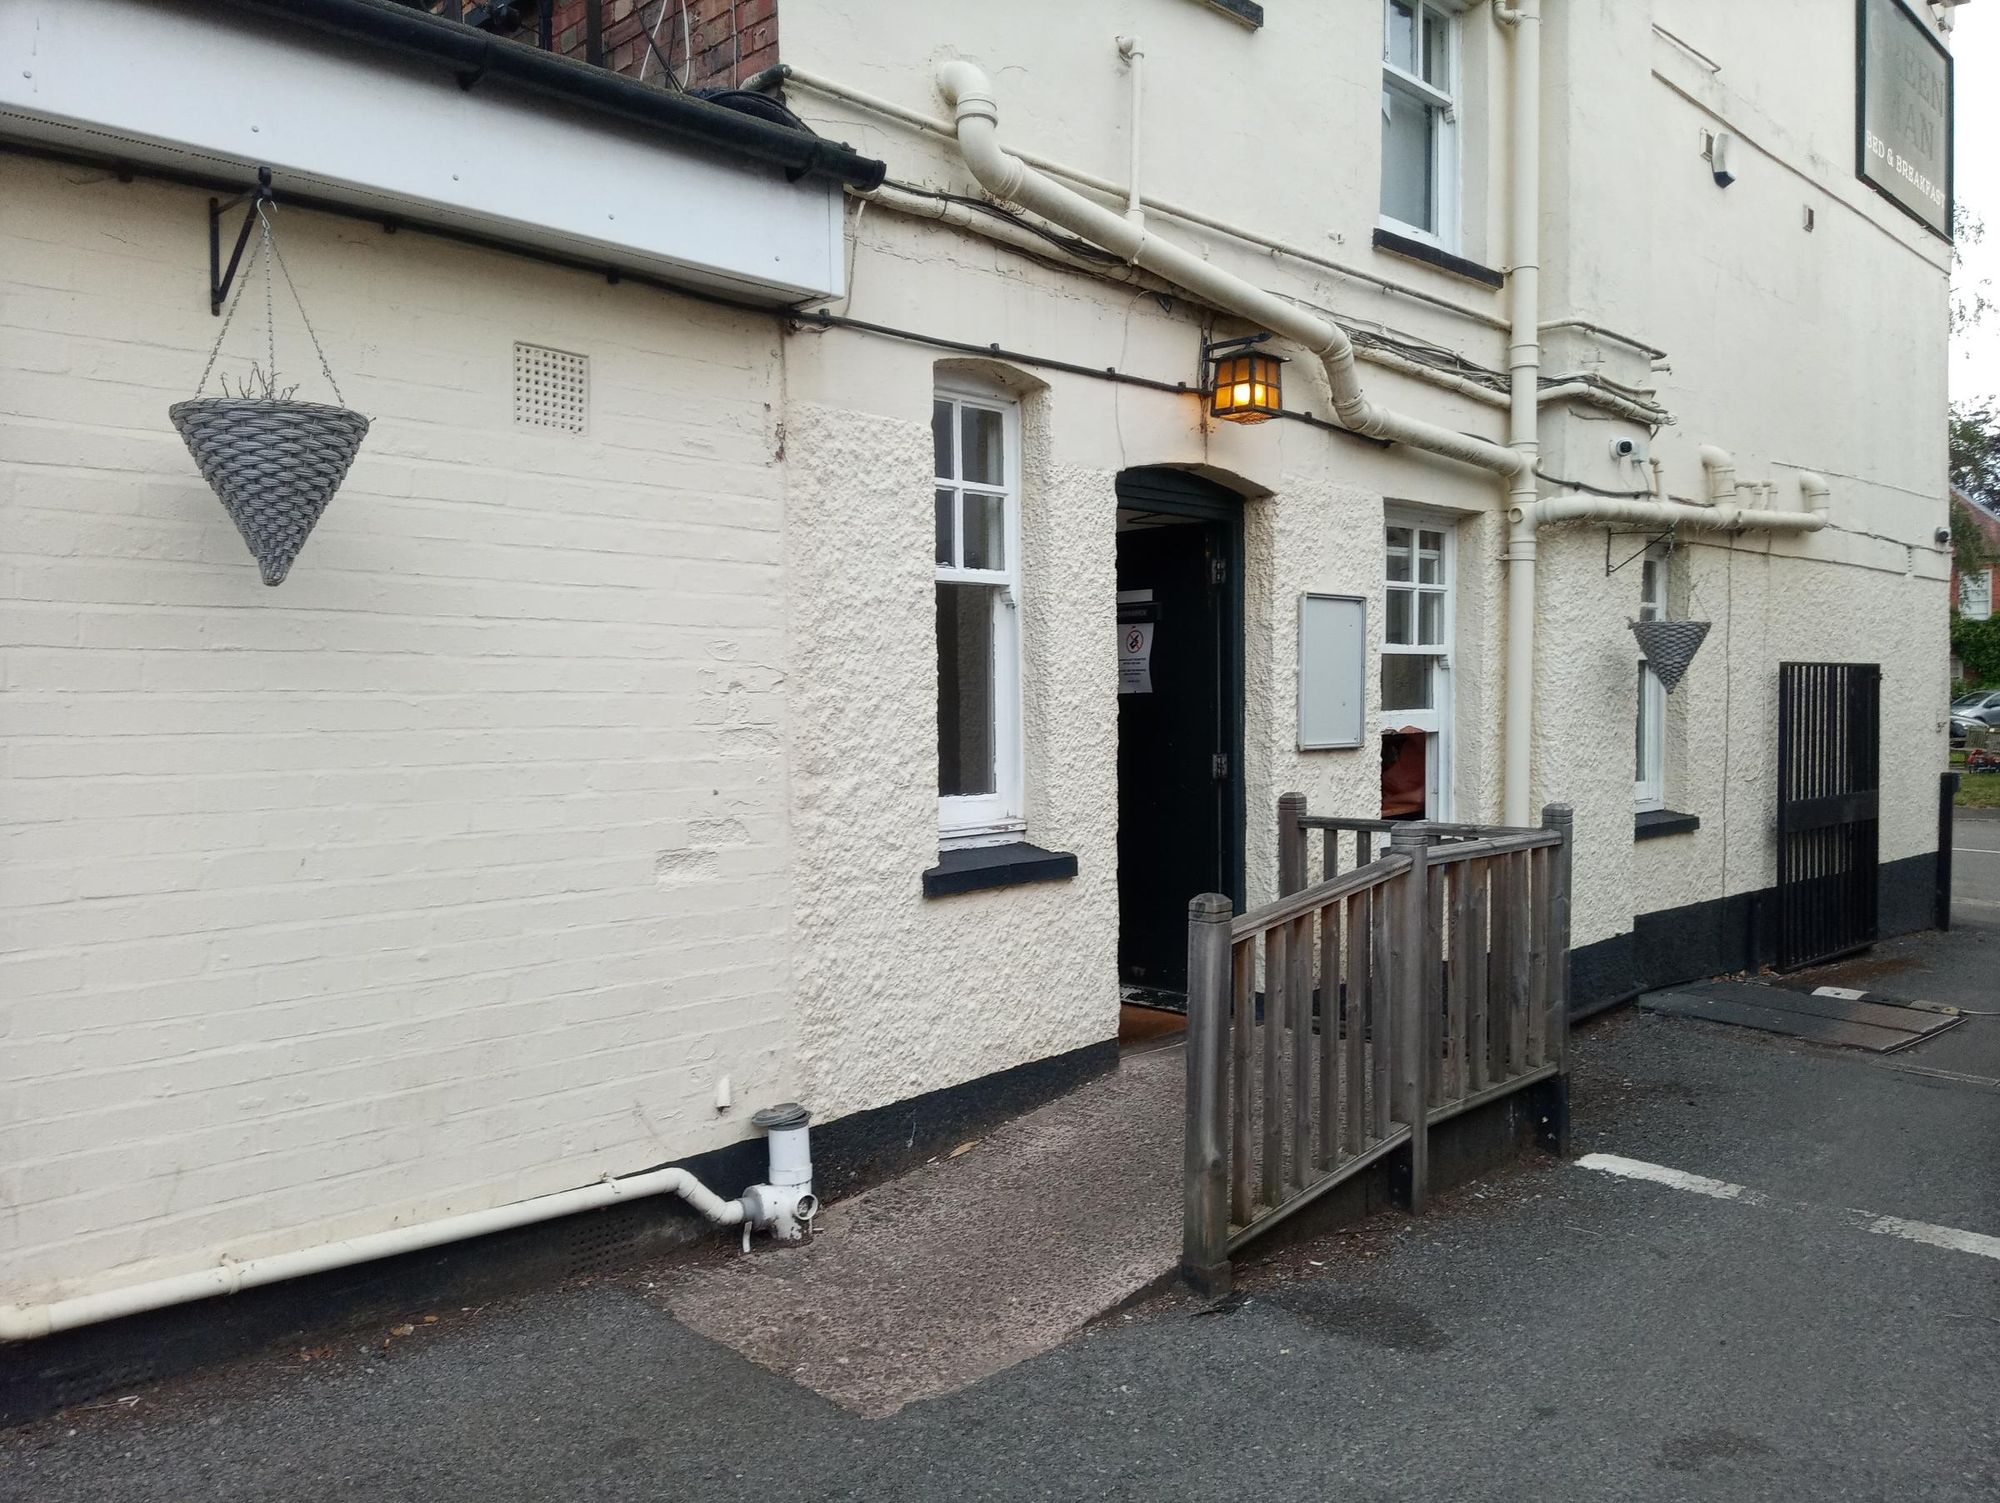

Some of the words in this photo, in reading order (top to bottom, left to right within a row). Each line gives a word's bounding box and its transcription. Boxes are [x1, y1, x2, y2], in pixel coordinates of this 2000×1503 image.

[1866, 130, 1885, 158] BED
[1887, 147, 1894, 168] &
[1896, 154, 1945, 209] BREAKFAST
